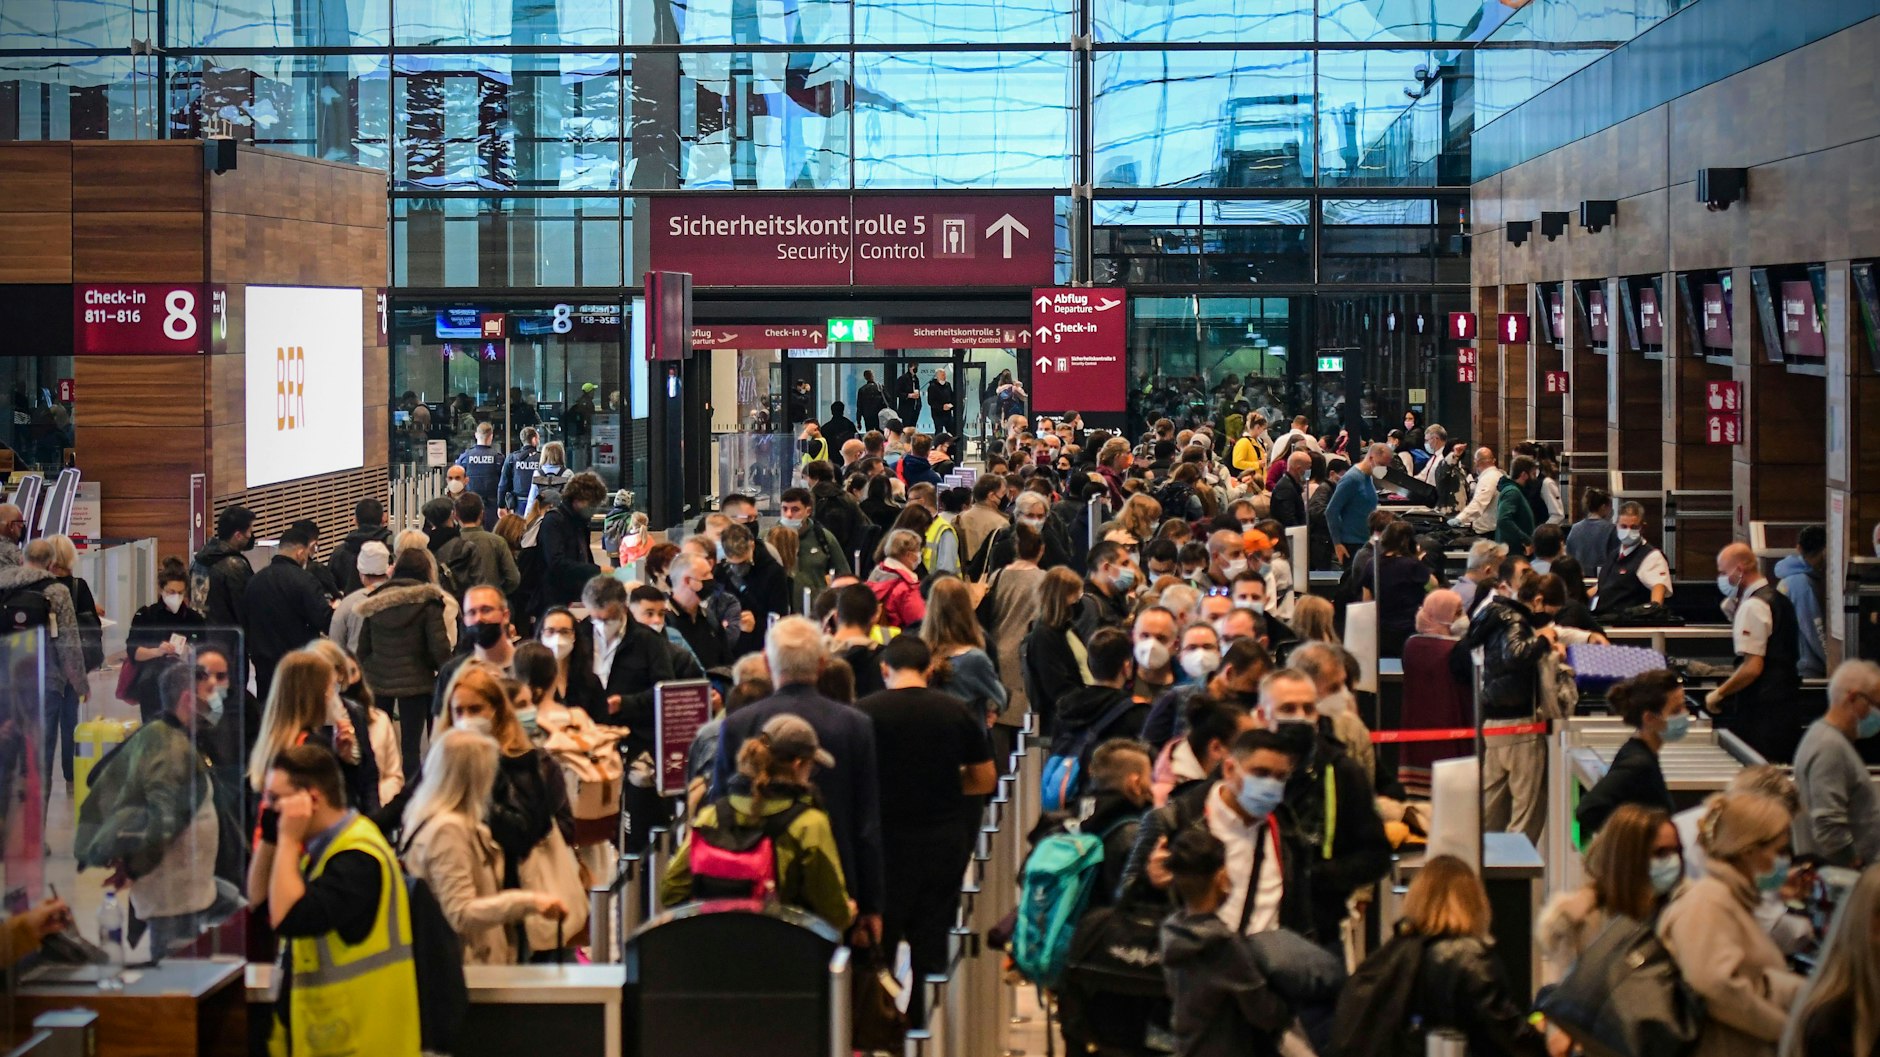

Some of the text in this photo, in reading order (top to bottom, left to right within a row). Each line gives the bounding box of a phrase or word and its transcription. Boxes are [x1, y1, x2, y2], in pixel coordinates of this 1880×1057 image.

[669, 214, 926, 236] Sicherheitskontrolle 5
[777, 242, 925, 264] Security Control
[84, 289, 147, 304] Check-in
[1053, 293, 1089, 306] Abflug
[84, 309, 142, 323] 811–816
[163, 289, 198, 340] 8
[220, 290, 227, 340] 8
[381, 293, 388, 335] 8
[1054, 305, 1093, 314] Departure
[764, 328, 808, 337] Check-in 9
[913, 328, 1001, 337] Sicherheitskontrolle 5
[1054, 322, 1097, 332] Check-in
[951, 336, 1001, 345] Security Control
[1054, 334, 1061, 343] 9
[276, 345, 304, 431] BER
[468, 455, 495, 464] POLIZEI
